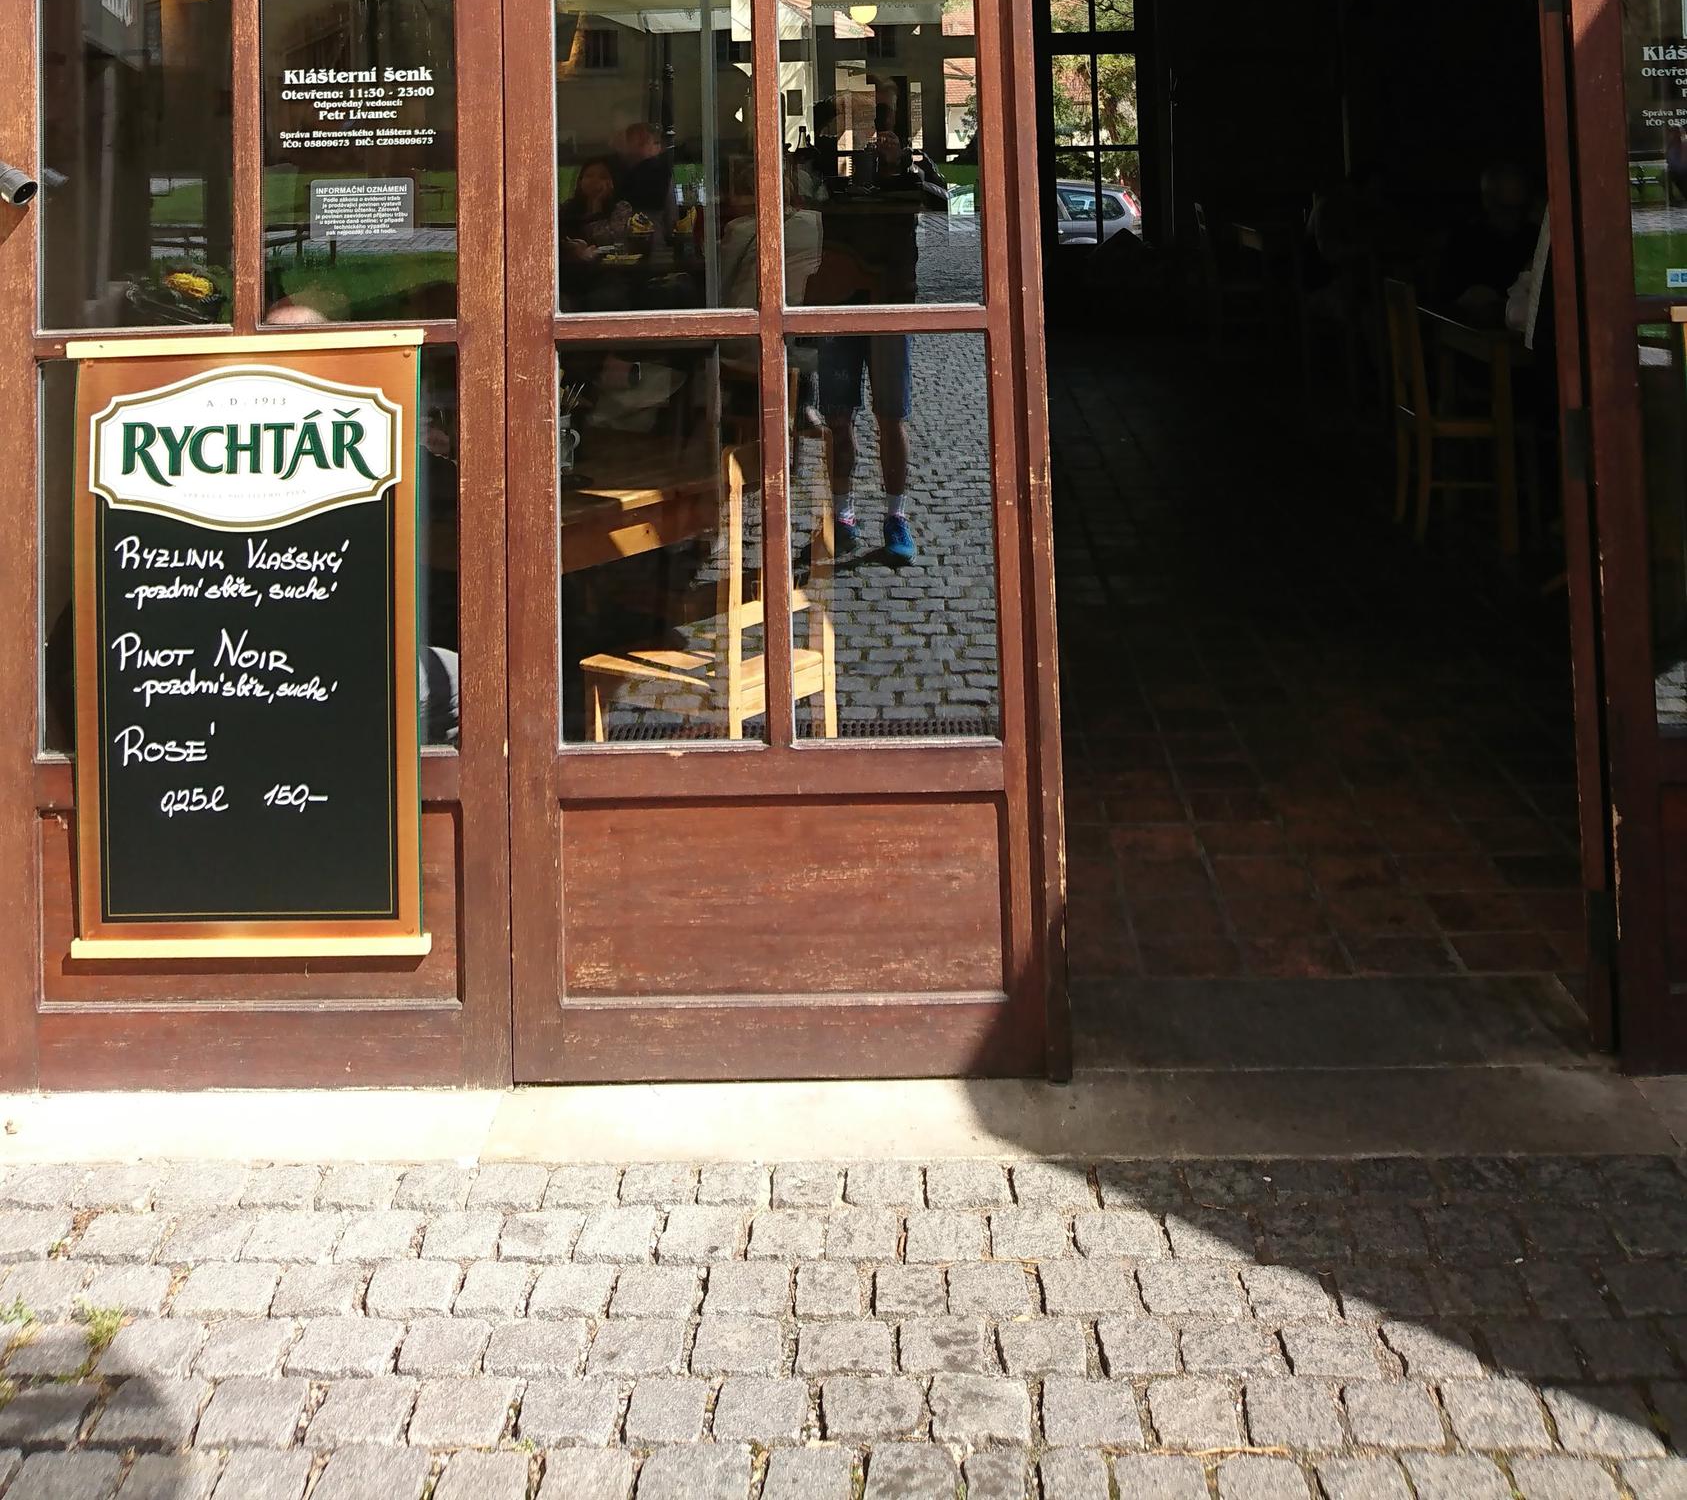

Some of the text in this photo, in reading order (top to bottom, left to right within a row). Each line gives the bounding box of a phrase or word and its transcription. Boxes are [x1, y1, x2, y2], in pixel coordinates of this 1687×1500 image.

[283, 66, 433, 85] Klášterní šenk
[281, 89, 344, 100] Otevřeno:
[349, 88, 385, 98] 11:30
[397, 87, 435, 97] 23:00
[313, 98, 403, 110] Odpovědný vedoucí:
[318, 110, 346, 120] Petr
[280, 128, 437, 140] Správa Břevnovského kláštera s.r.o.
[283, 140, 302, 149] IČO:
[355, 138, 374, 147] DIČ:
[315, 184, 408, 195] INFORMAČNÍ OZNÁMENÍ
[121, 407, 382, 487] RYCHTÁŘ
